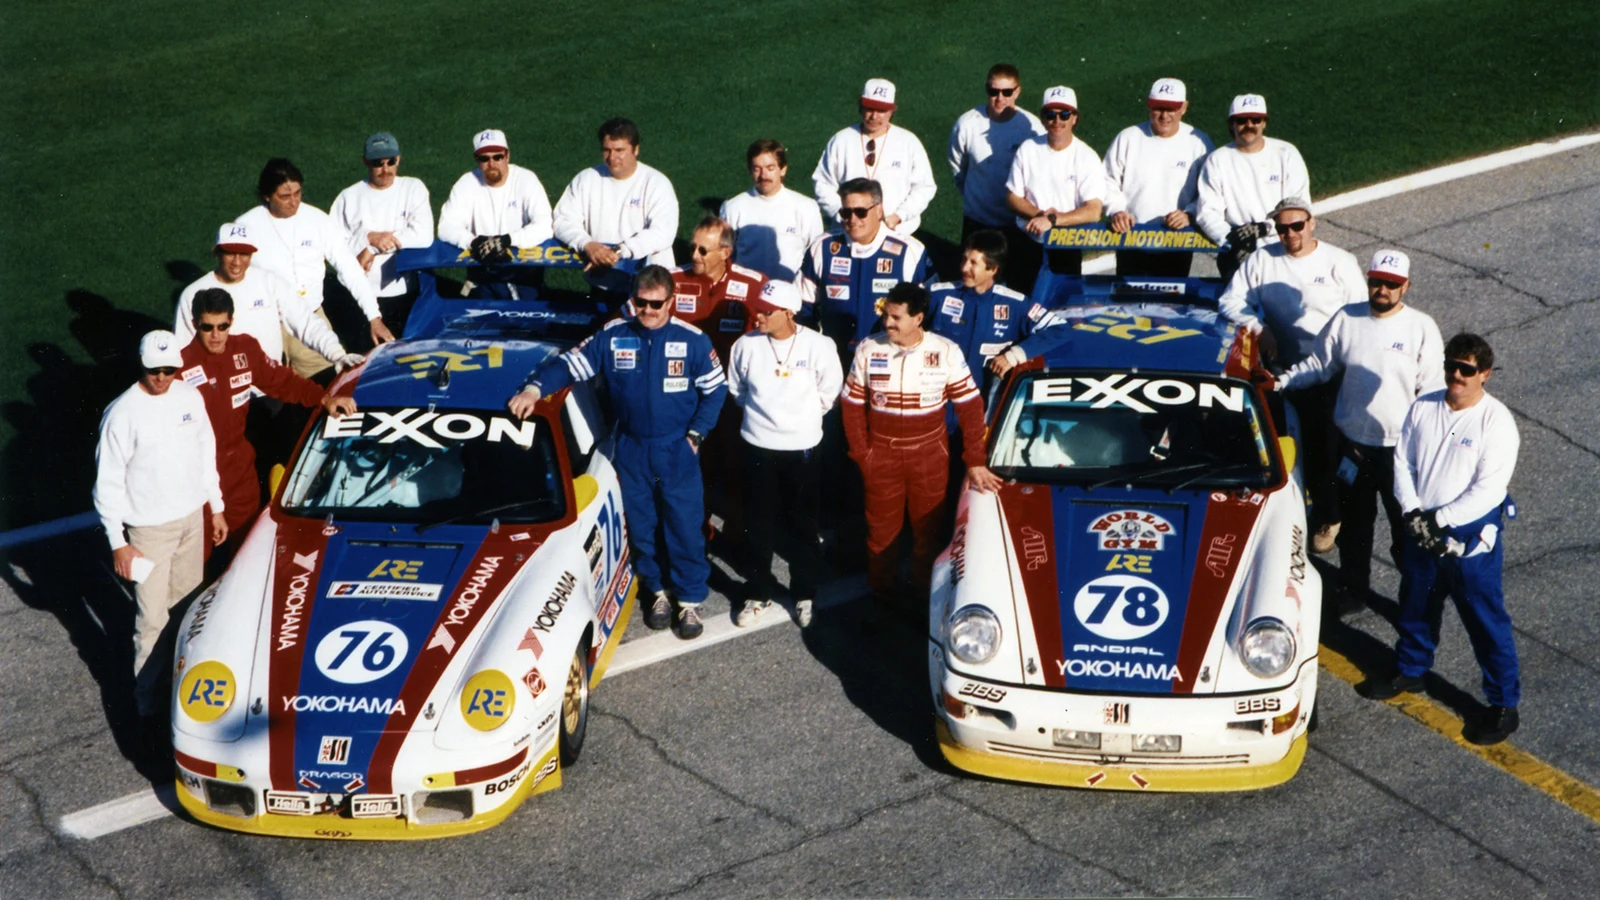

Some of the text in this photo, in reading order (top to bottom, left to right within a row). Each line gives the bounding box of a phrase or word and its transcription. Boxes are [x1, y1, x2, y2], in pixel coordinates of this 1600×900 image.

[1048, 228, 1122, 246] PRECISION
[1032, 374, 1244, 414] EXXON
[323, 408, 536, 449] EXXON
[1092, 511, 1171, 533] WORLD
[597, 490, 622, 585] 76
[1103, 539, 1158, 549] GYM
[367, 559, 424, 580] ARE
[1105, 554, 1152, 573] ARE
[445, 556, 503, 625] YOKOHAMA
[533, 570, 577, 633] YOKOHAMA
[277, 572, 311, 651] YOKOHAMA
[1084, 585, 1160, 627] 78
[326, 630, 395, 672] 76
[1073, 644, 1164, 657] ANDIAL
[1056, 659, 1183, 682] YOKOHAMA
[187, 679, 227, 706] ARE
[467, 688, 507, 717] ARE
[958, 680, 1007, 702] BBS
[282, 696, 406, 716] YOKOHAMA
[1235, 697, 1281, 715] BBS
[484, 761, 531, 795] BOSCH
